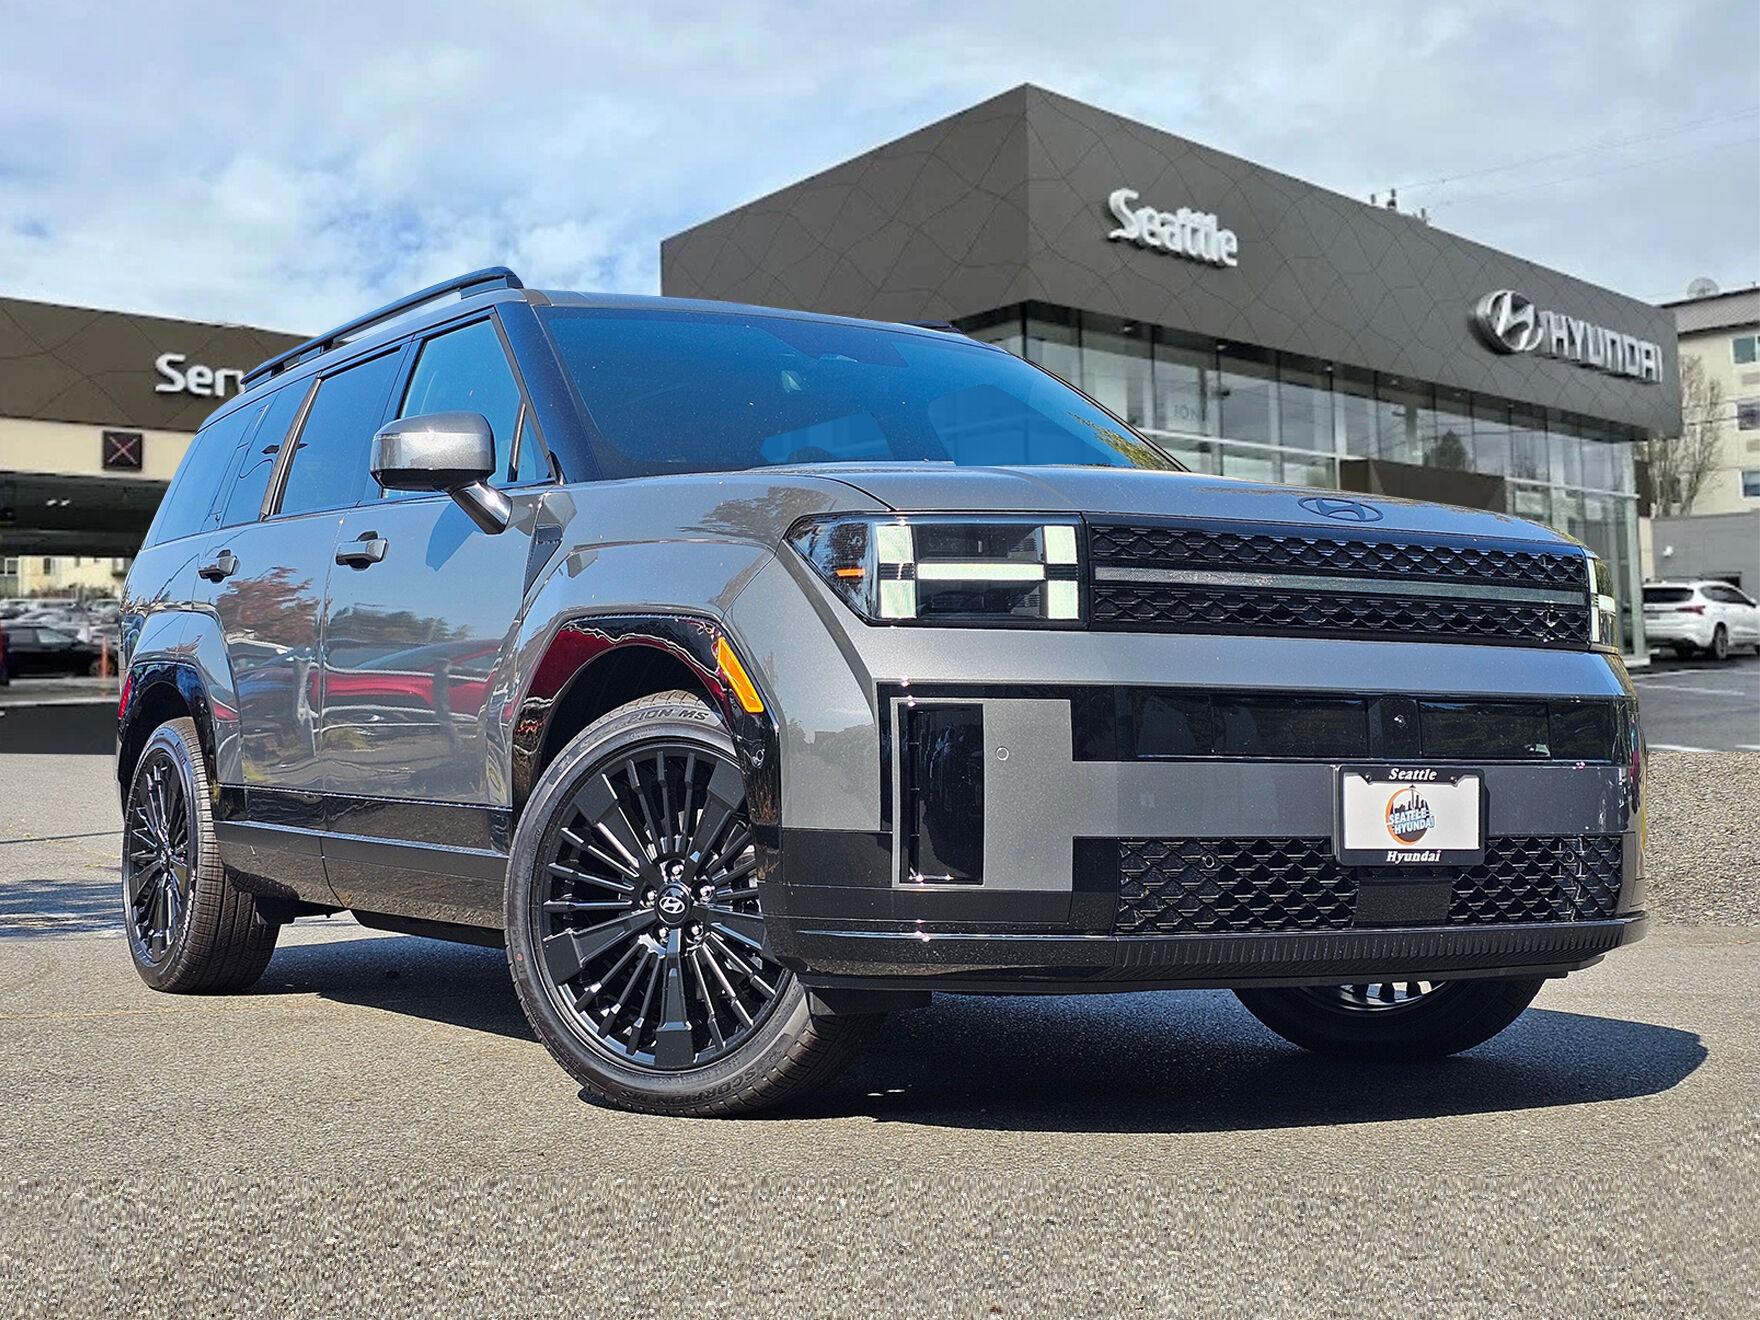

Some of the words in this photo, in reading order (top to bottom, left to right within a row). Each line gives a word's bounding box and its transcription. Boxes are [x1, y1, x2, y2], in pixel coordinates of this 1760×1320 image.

[1108, 187, 1238, 267] Seattle
[1538, 311, 1663, 383] HYUNDAI
[678, 710, 709, 721] MS
[1388, 768, 1437, 781] Seattle
[1389, 808, 1427, 824] SEATTLE
[1394, 815, 1435, 835] HYUNDAI
[1386, 850, 1441, 864] Hyundai
